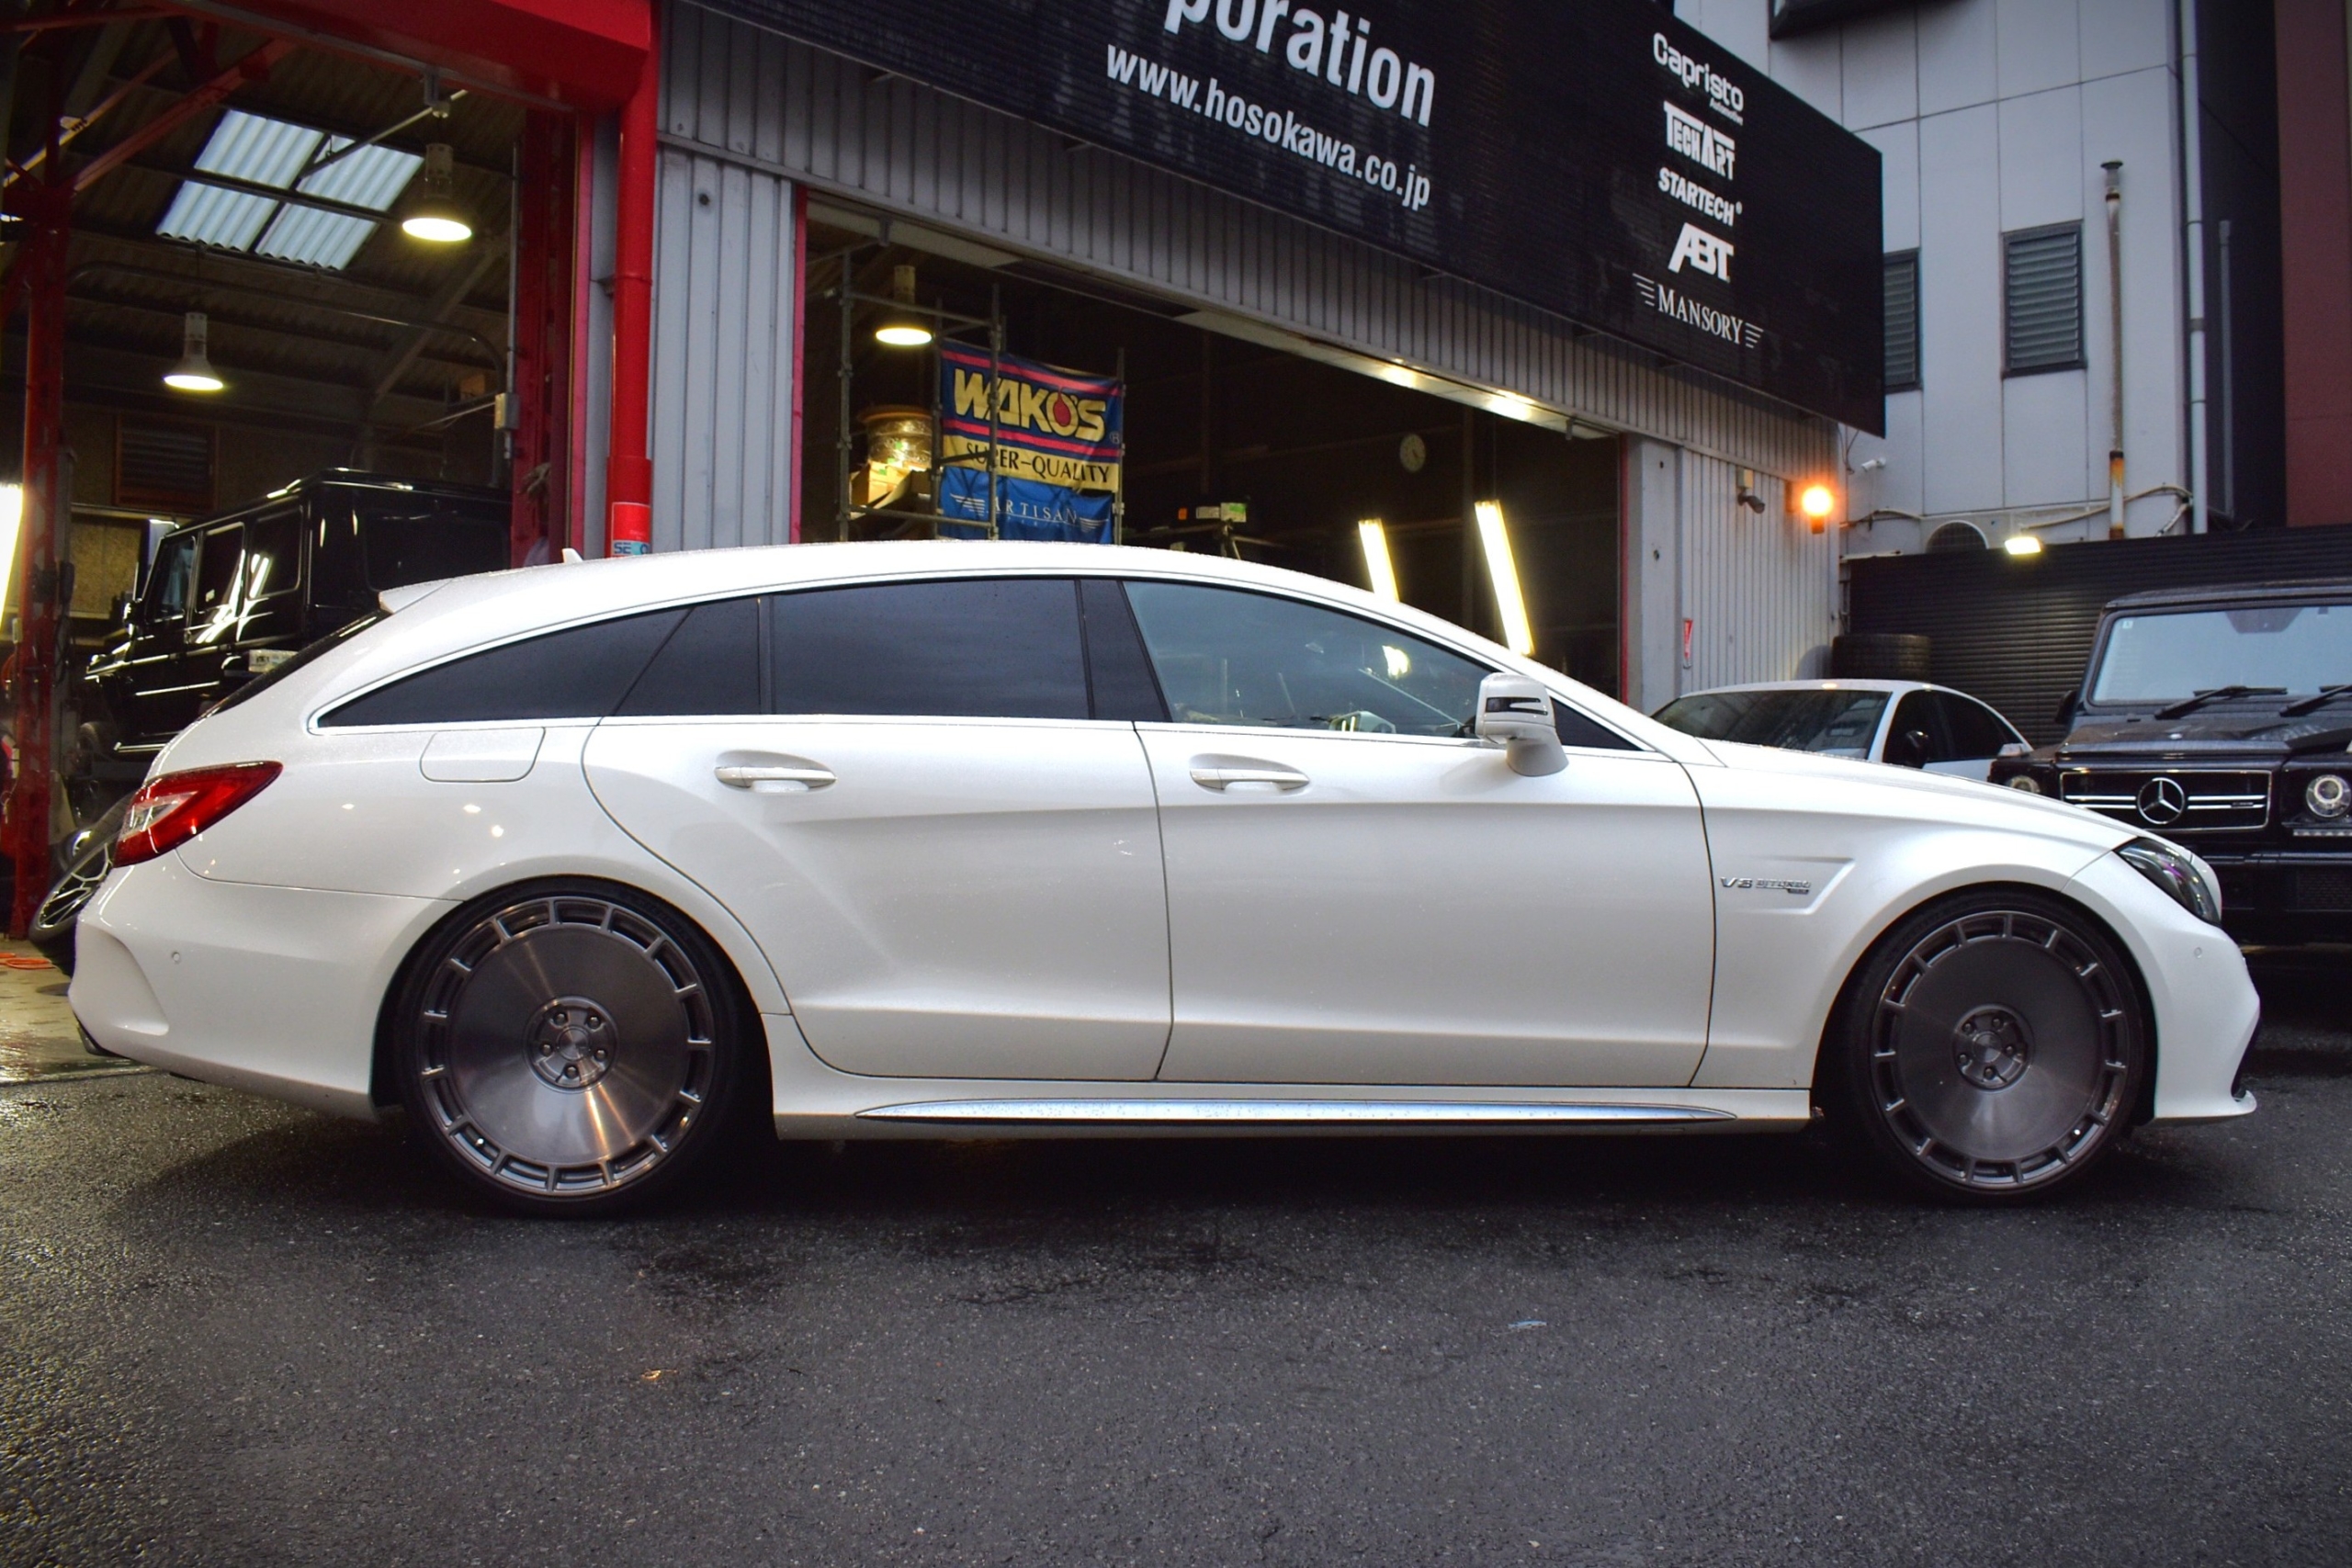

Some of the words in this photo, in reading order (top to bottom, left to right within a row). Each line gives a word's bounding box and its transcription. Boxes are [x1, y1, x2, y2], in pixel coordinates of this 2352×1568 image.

[1653, 32, 1744, 111] Capristo
[1107, 44, 1430, 211] www.hosokawa.co.jp
[1668, 222, 1735, 283] ABT
[1657, 284, 1744, 344] MANSORY
[967, 443, 1110, 483] SUER-QUALITY
[1720, 876, 1753, 888] V8
